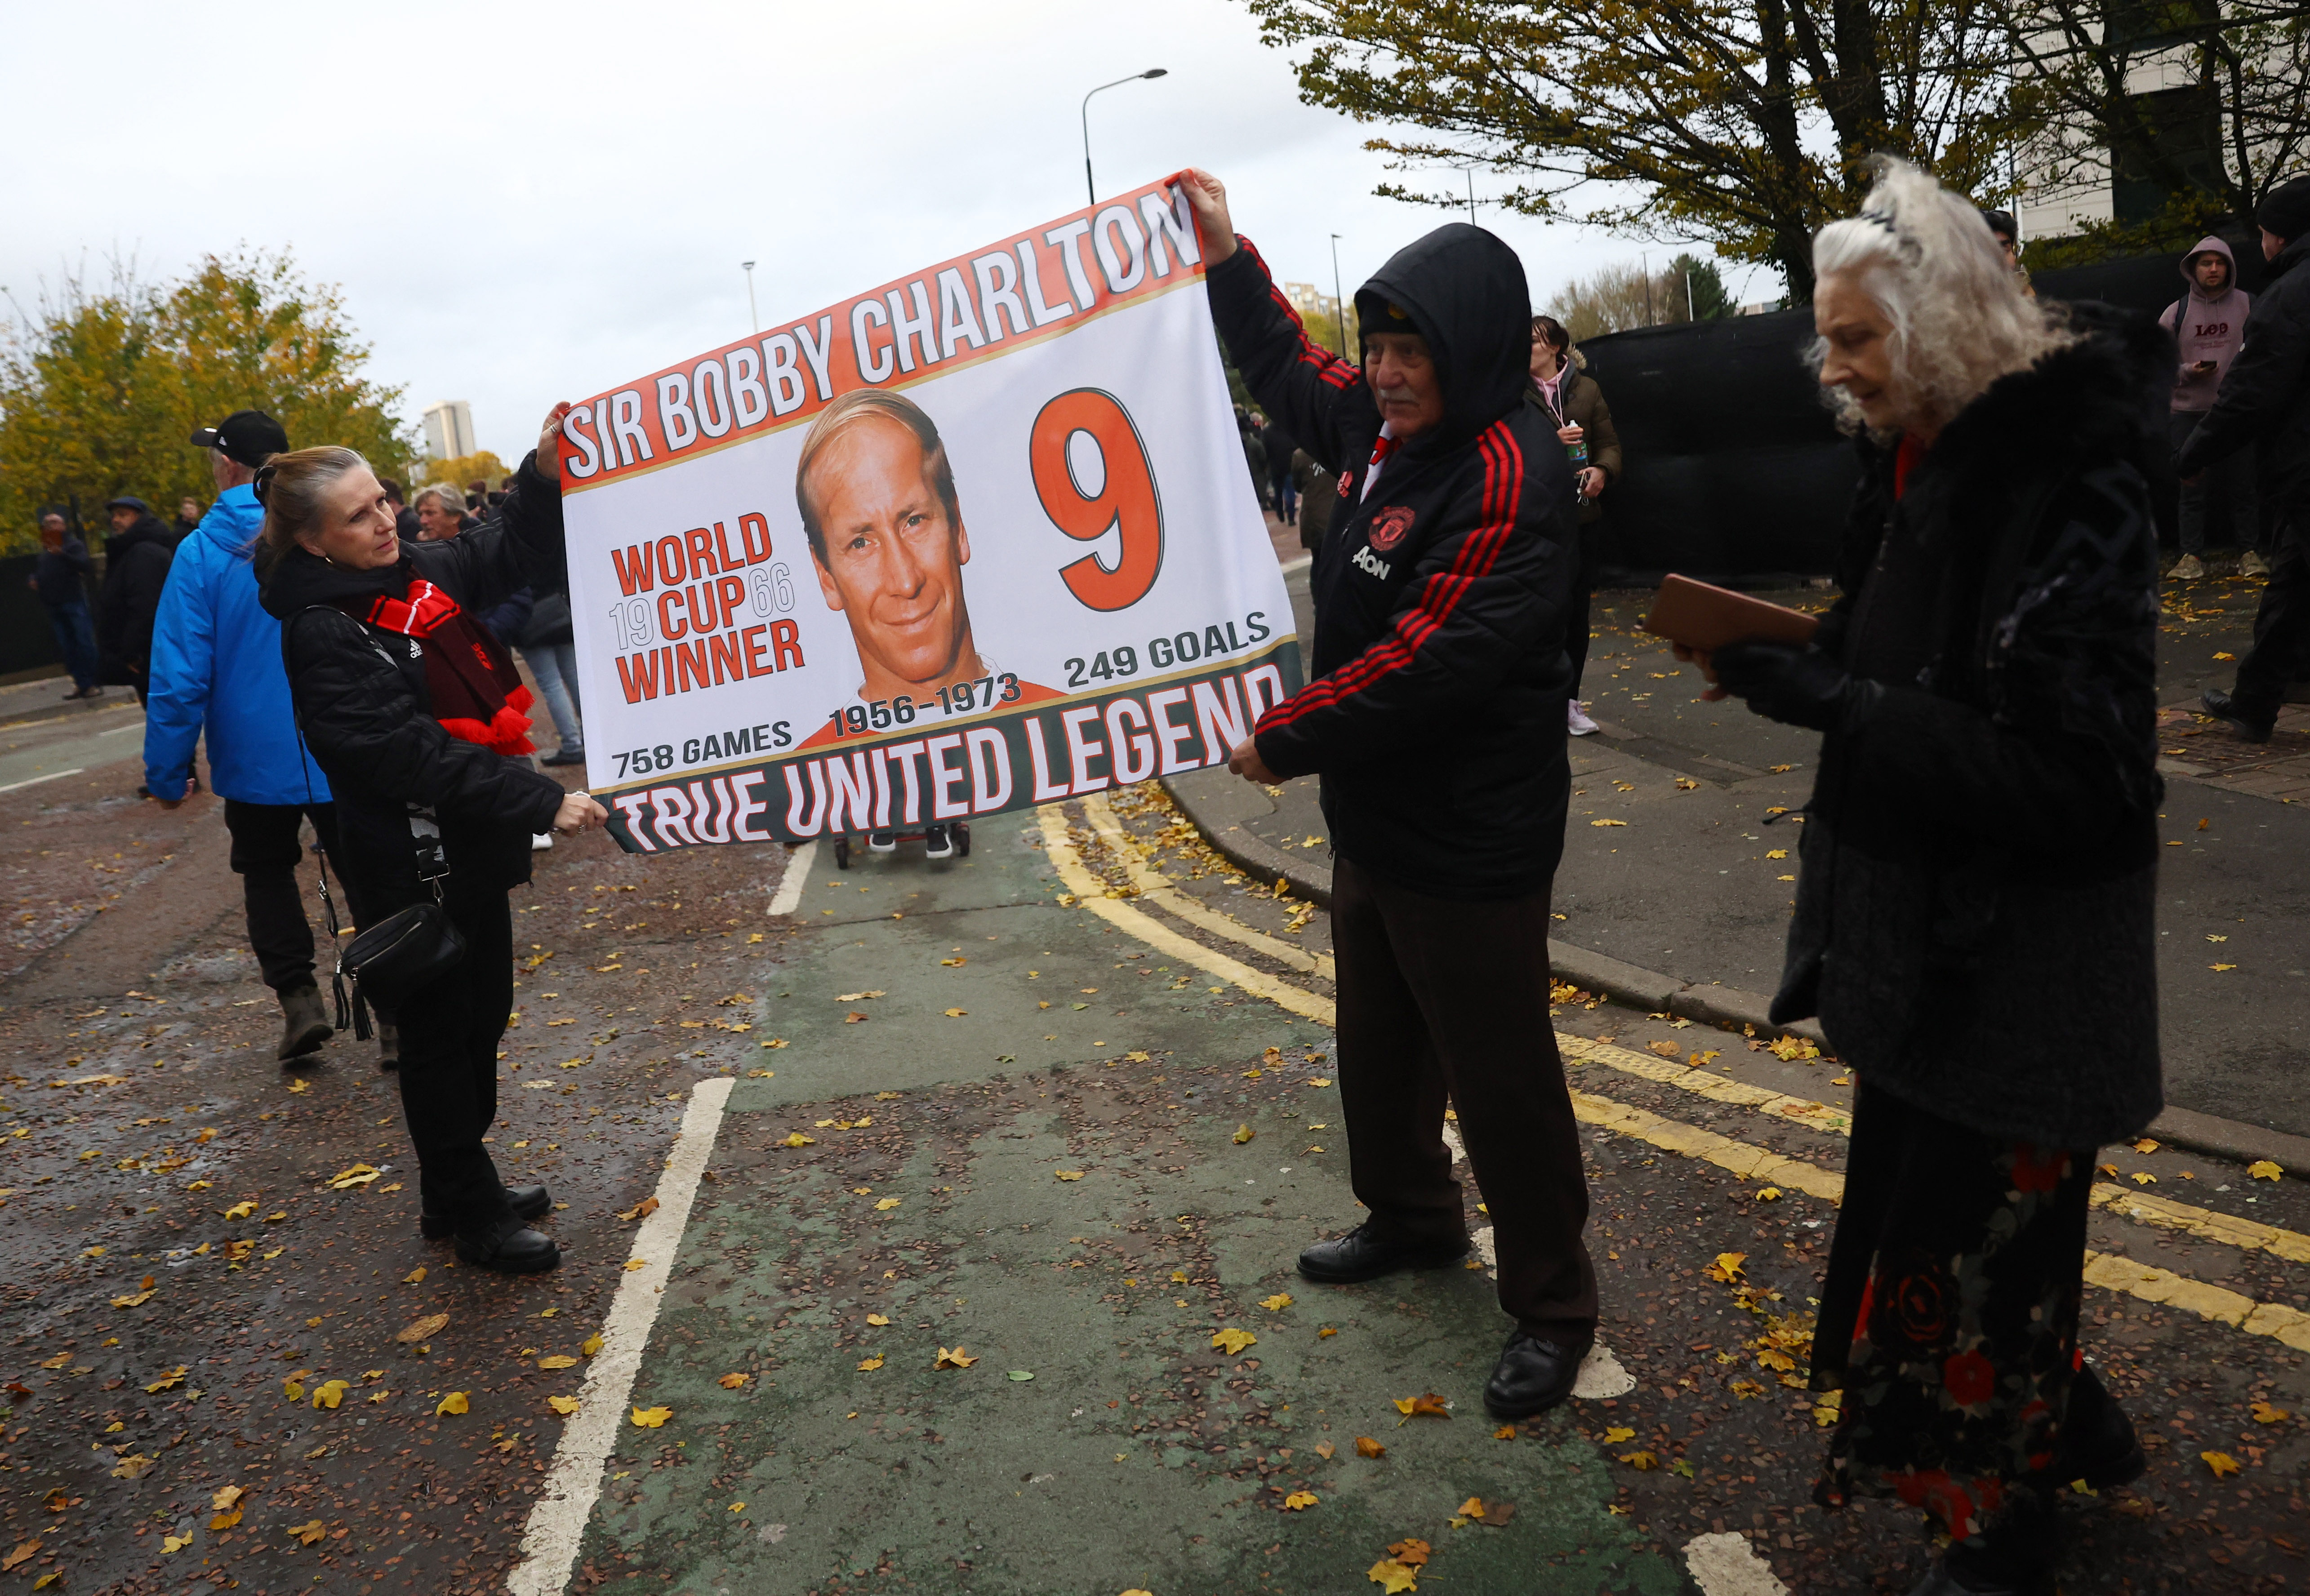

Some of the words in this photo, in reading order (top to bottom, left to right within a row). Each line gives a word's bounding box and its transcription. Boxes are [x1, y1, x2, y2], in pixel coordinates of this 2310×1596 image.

[563, 389, 654, 479] SIR
[657, 314, 834, 451] BOBBY
[849, 181, 1202, 385] CHARLTON
[1029, 387, 1164, 612] 9
[611, 511, 772, 597] WORLD
[609, 598, 654, 650] 19
[657, 576, 746, 640] CUP
[748, 562, 795, 618] 66
[1064, 646, 1138, 688] 249
[1148, 611, 1270, 669] GOALS
[615, 618, 806, 705] WINNER
[612, 744, 674, 779] 758
[682, 720, 792, 765] GAMES
[612, 770, 772, 852] TRUE
[782, 726, 1013, 837] UNITED
